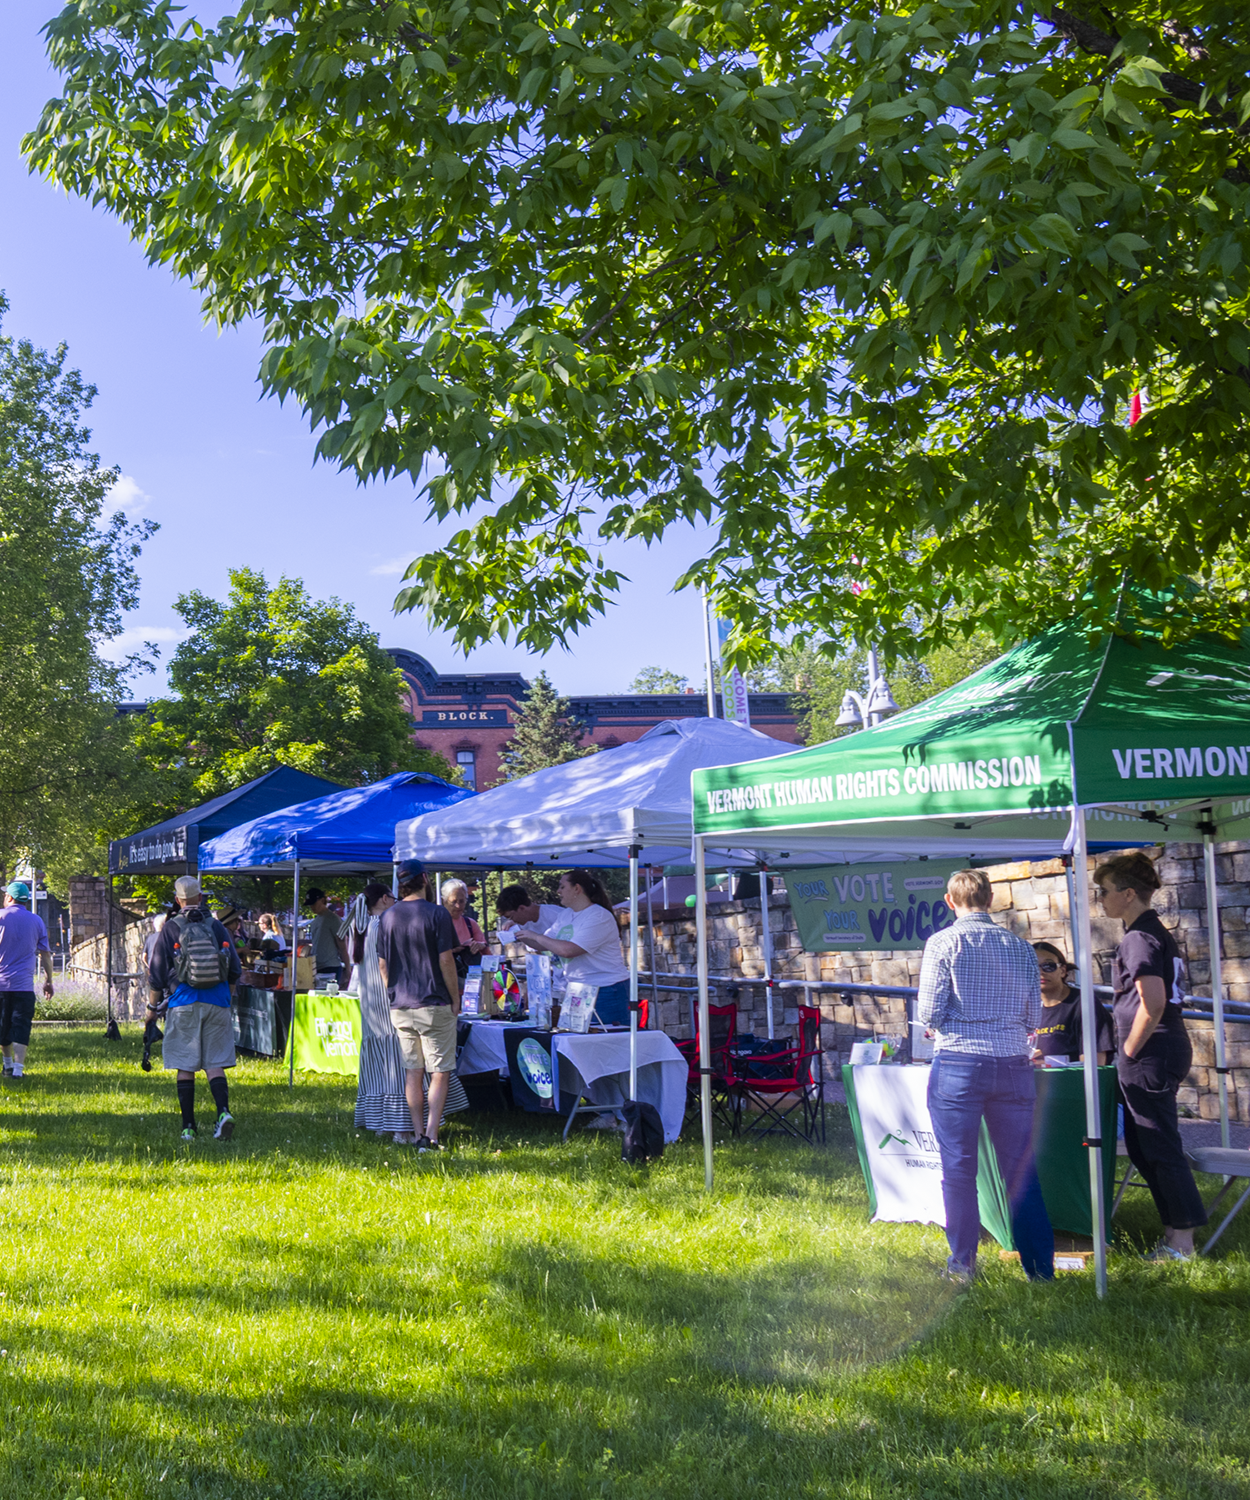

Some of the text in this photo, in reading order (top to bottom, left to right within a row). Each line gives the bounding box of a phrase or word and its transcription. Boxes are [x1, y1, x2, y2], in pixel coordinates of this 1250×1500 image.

[437, 711, 494, 721] BLOCK.
[1112, 746, 1250, 779] VERMON
[706, 755, 1042, 814] VERMONT HUMAN RIGHTS COMMISSION
[138, 846, 149, 865] easy
[149, 842, 155, 860] to
[155, 838, 162, 859] do
[794, 880, 829, 898] YOUR
[823, 893, 956, 943] YOUR voice
[314, 1017, 353, 1041] Efficiency
[320, 1036, 358, 1057] Vermont
[524, 1053, 549, 1066] VOTE
